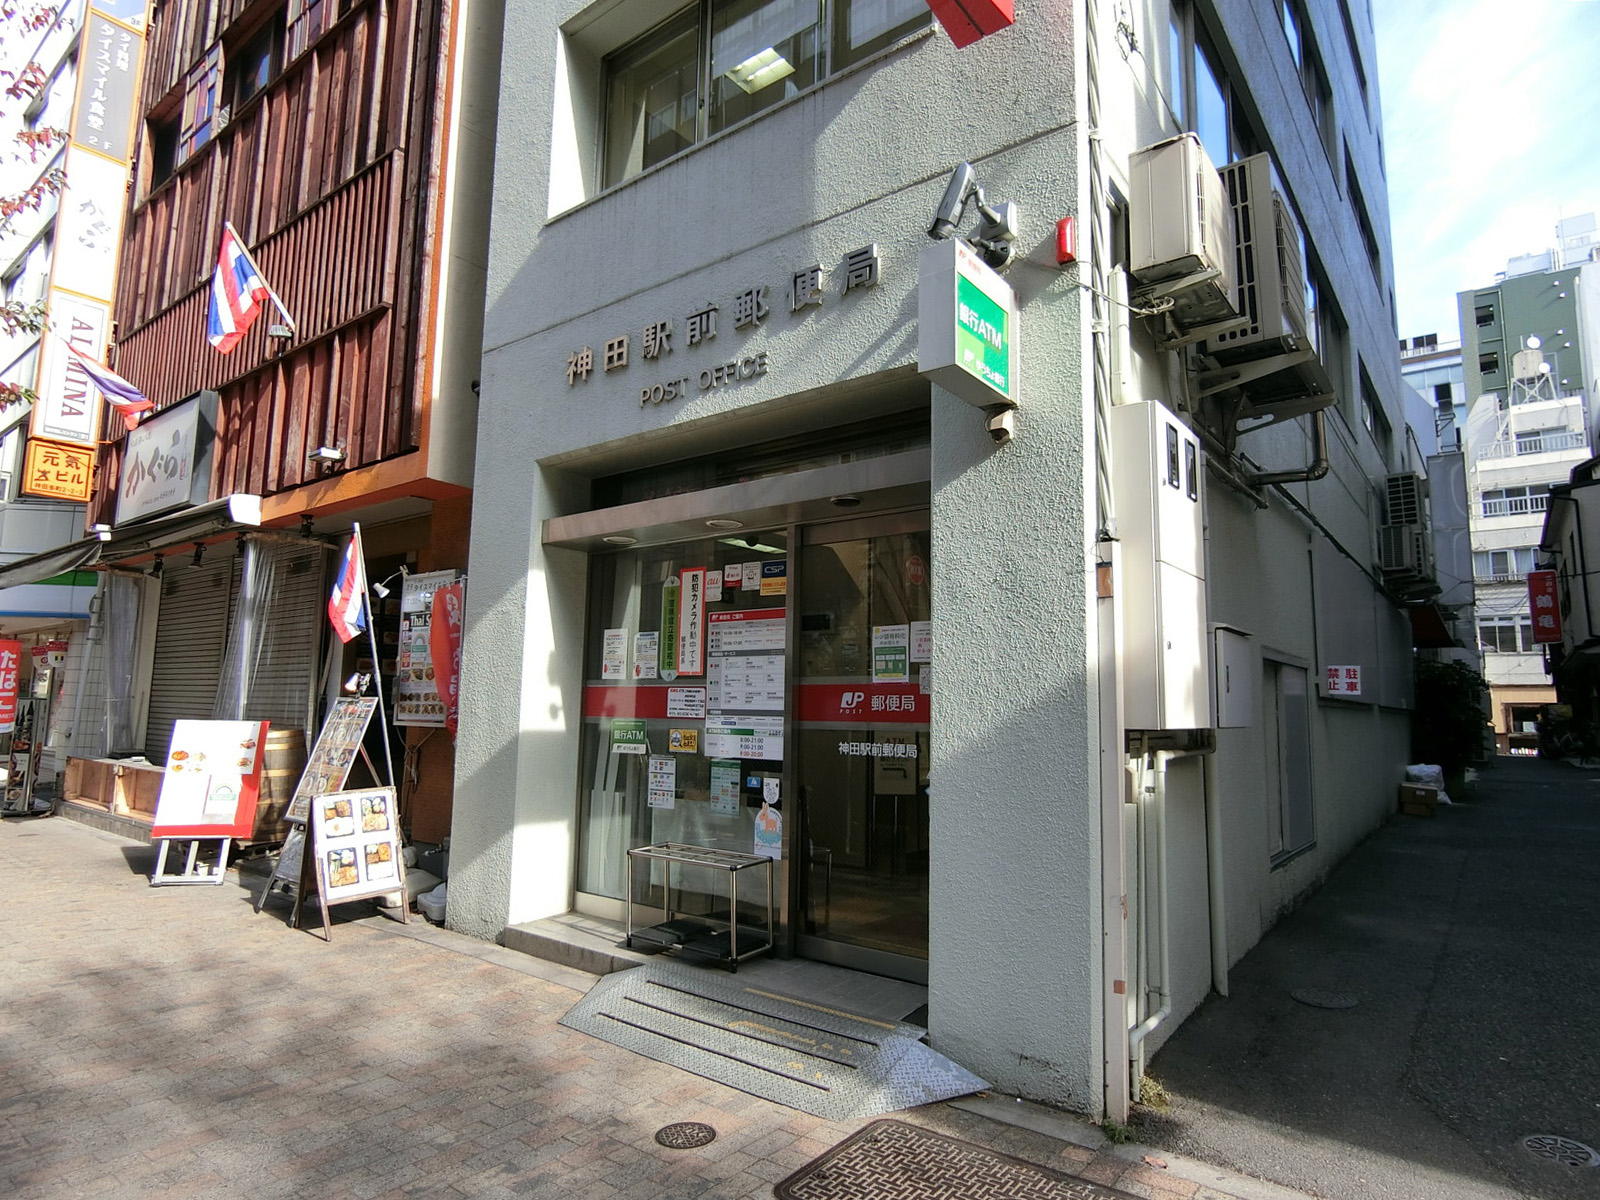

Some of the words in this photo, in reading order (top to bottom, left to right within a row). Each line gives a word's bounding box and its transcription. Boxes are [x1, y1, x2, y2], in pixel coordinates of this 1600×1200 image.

[86, 23, 115, 132] タイスマイル食堂
[566, 242, 881, 386] 神田駅前郵便局
[959, 302, 1002, 350] 銀行ATM
[640, 377, 688, 408] POST
[699, 351, 769, 391] OFFICE
[42, 451, 81, 470] 元気
[126, 429, 180, 498] かぐら
[56, 470, 84, 485] ビル
[764, 565, 785, 574] CSP
[707, 577, 719, 586] au
[411, 614, 425, 626] Thai
[1328, 668, 1340, 690] 禁止
[1345, 668, 1358, 692] 駐車
[871, 695, 915, 712] 郵便局
[614, 729, 644, 740] 銀行ATM
[838, 741, 918, 759] 神田駅前郵便局
